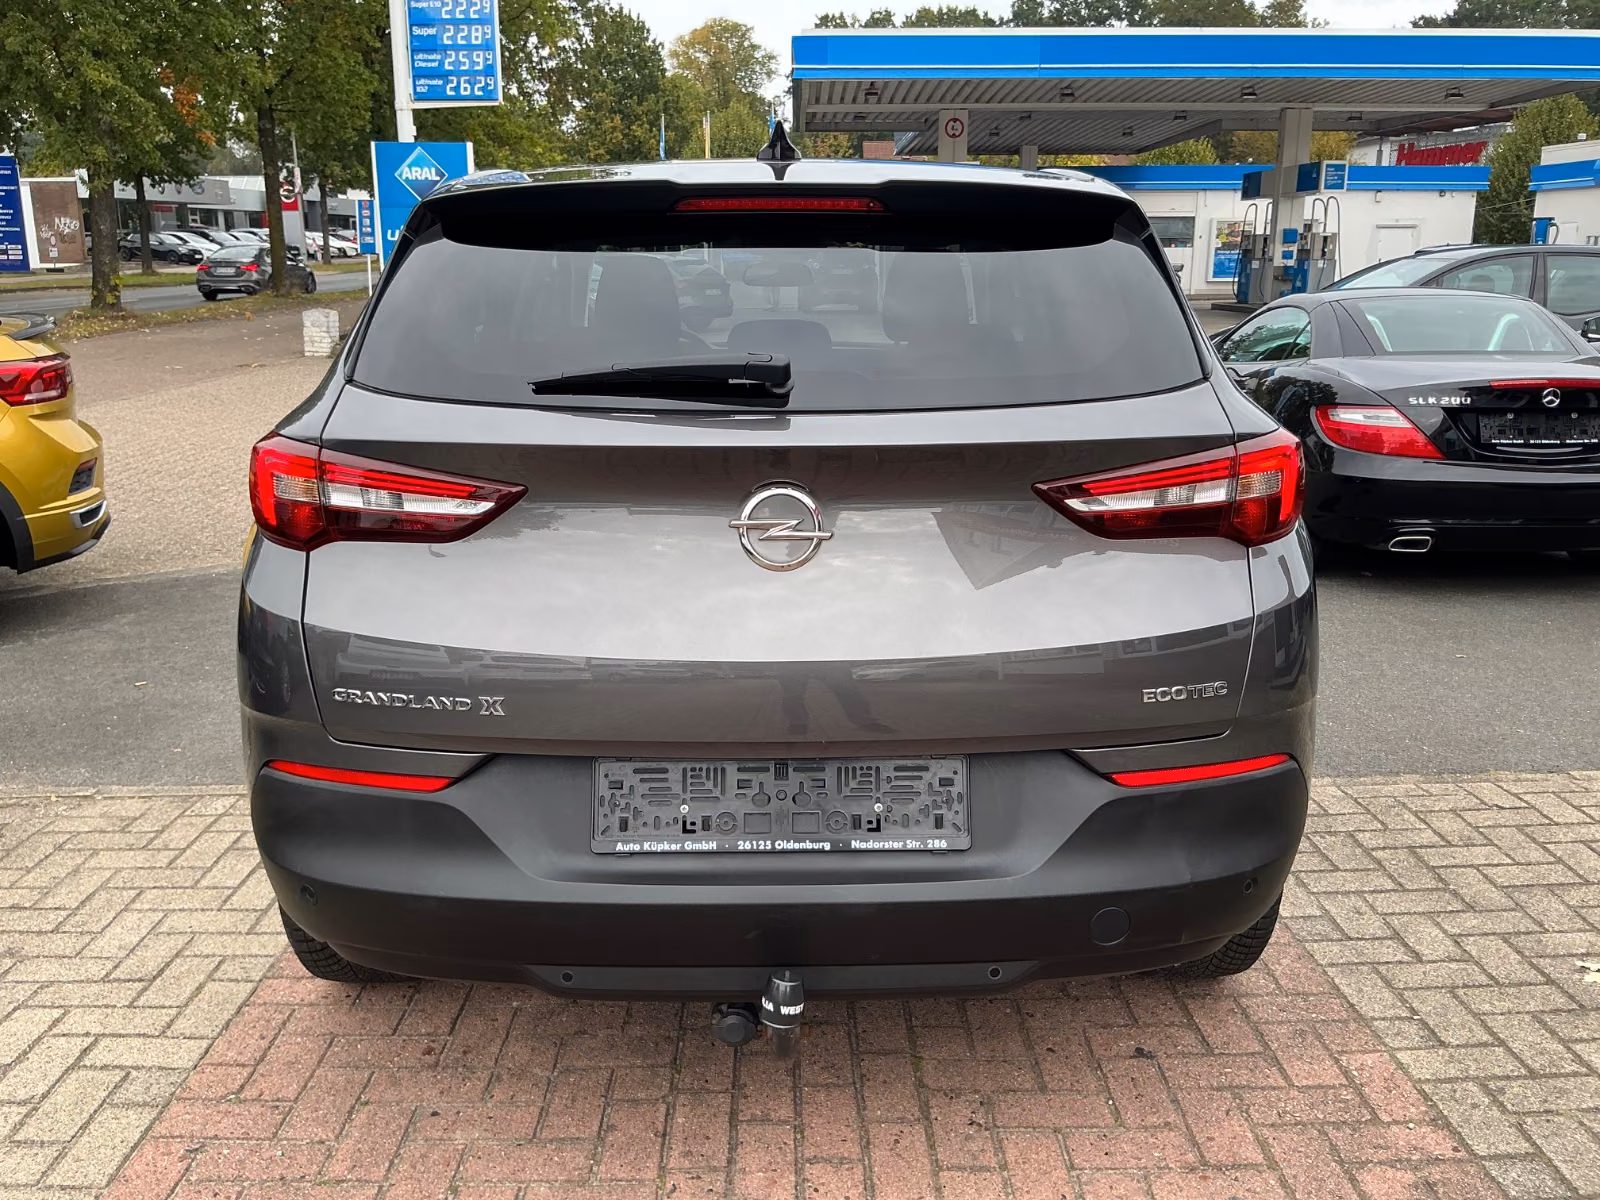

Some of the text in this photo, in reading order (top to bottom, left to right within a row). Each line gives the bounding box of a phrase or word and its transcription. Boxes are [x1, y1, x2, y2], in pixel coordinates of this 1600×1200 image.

[411, 26, 437, 36] Super
[414, 60, 439, 68] Diesel
[401, 167, 441, 180] ARAL
[1408, 396, 1472, 405] SLK 200
[1142, 681, 1228, 703] ECOTEC
[332, 688, 506, 716] GRANDLAND X
[615, 839, 948, 852] Auto Küpker GmbH 26125 Oldenburg Nadorster Str. 286
